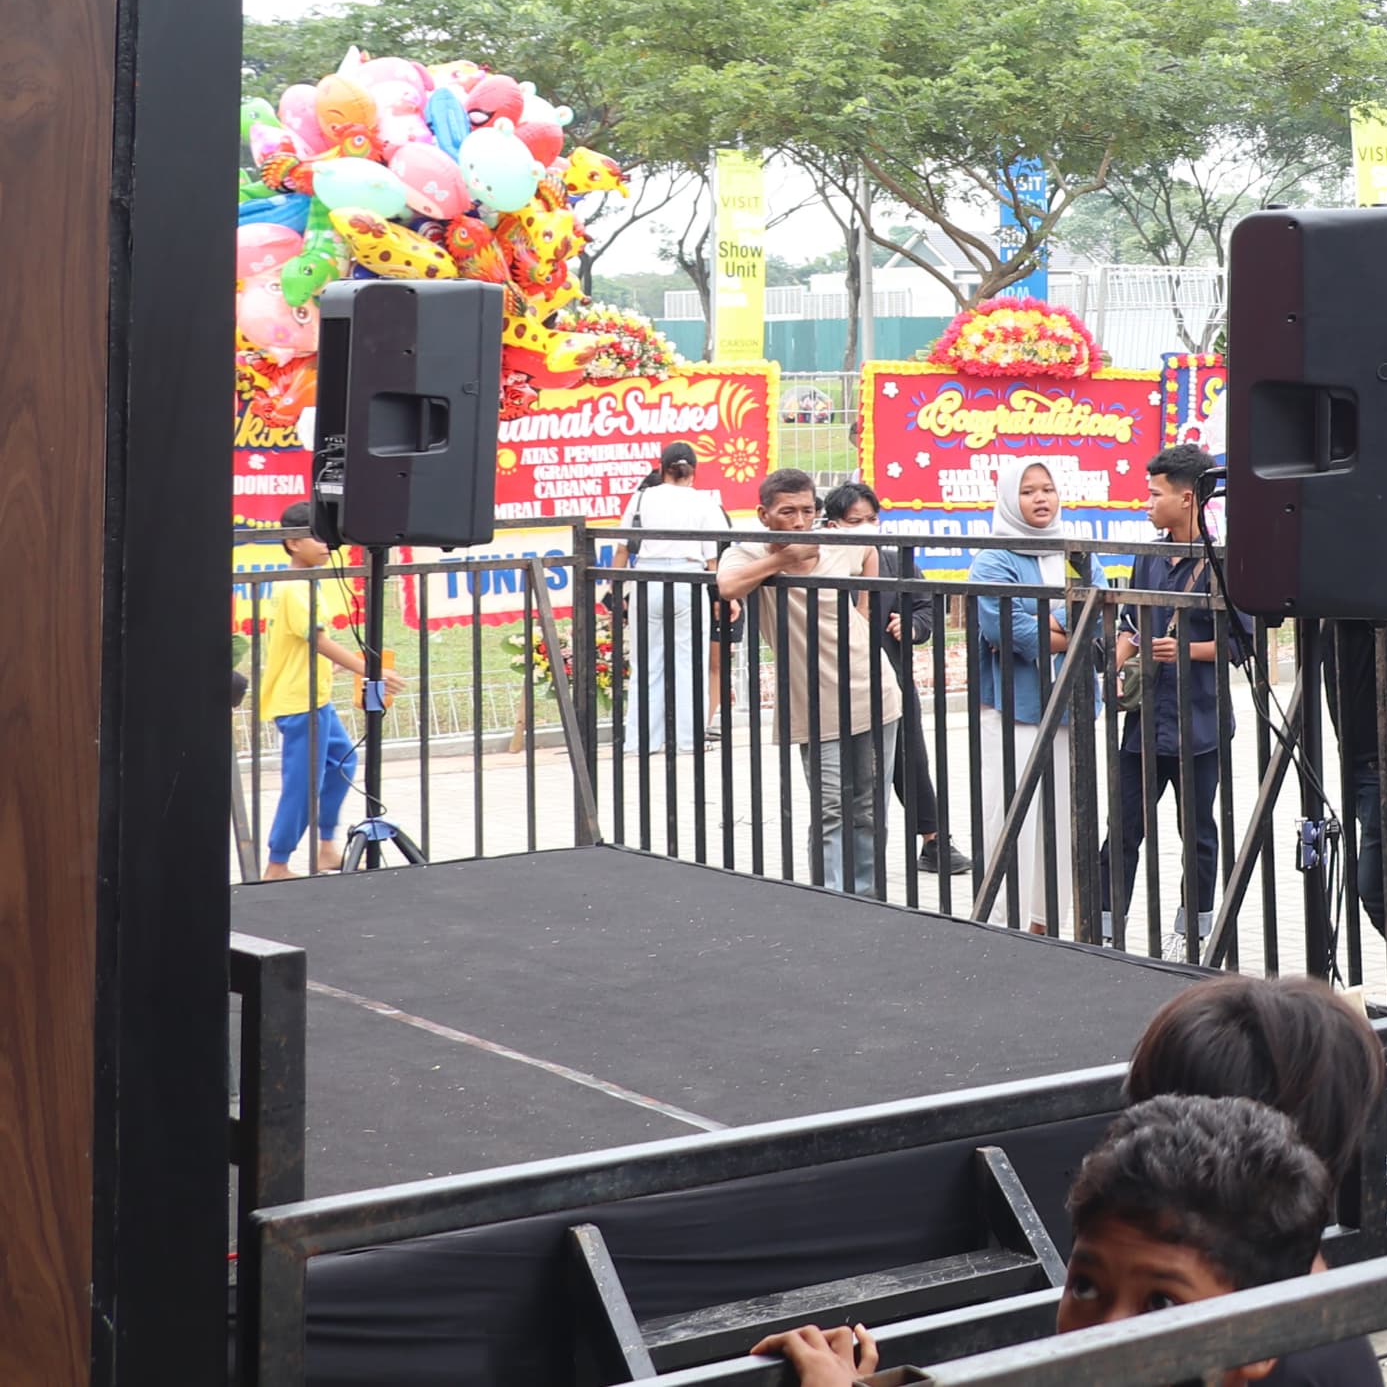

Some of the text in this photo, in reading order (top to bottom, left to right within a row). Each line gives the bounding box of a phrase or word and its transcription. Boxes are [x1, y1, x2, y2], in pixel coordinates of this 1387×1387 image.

[720, 196, 760, 209] VISIT
[718, 241, 762, 259] Show
[725, 262, 756, 278] Unit
[620, 391, 719, 435] Sukses
[917, 390, 1133, 449] Congratulations
[521, 442, 661, 465] ATAS PEMBUKAAN
[534, 480, 602, 499] CABANG
[553, 495, 621, 516] BAKAR
